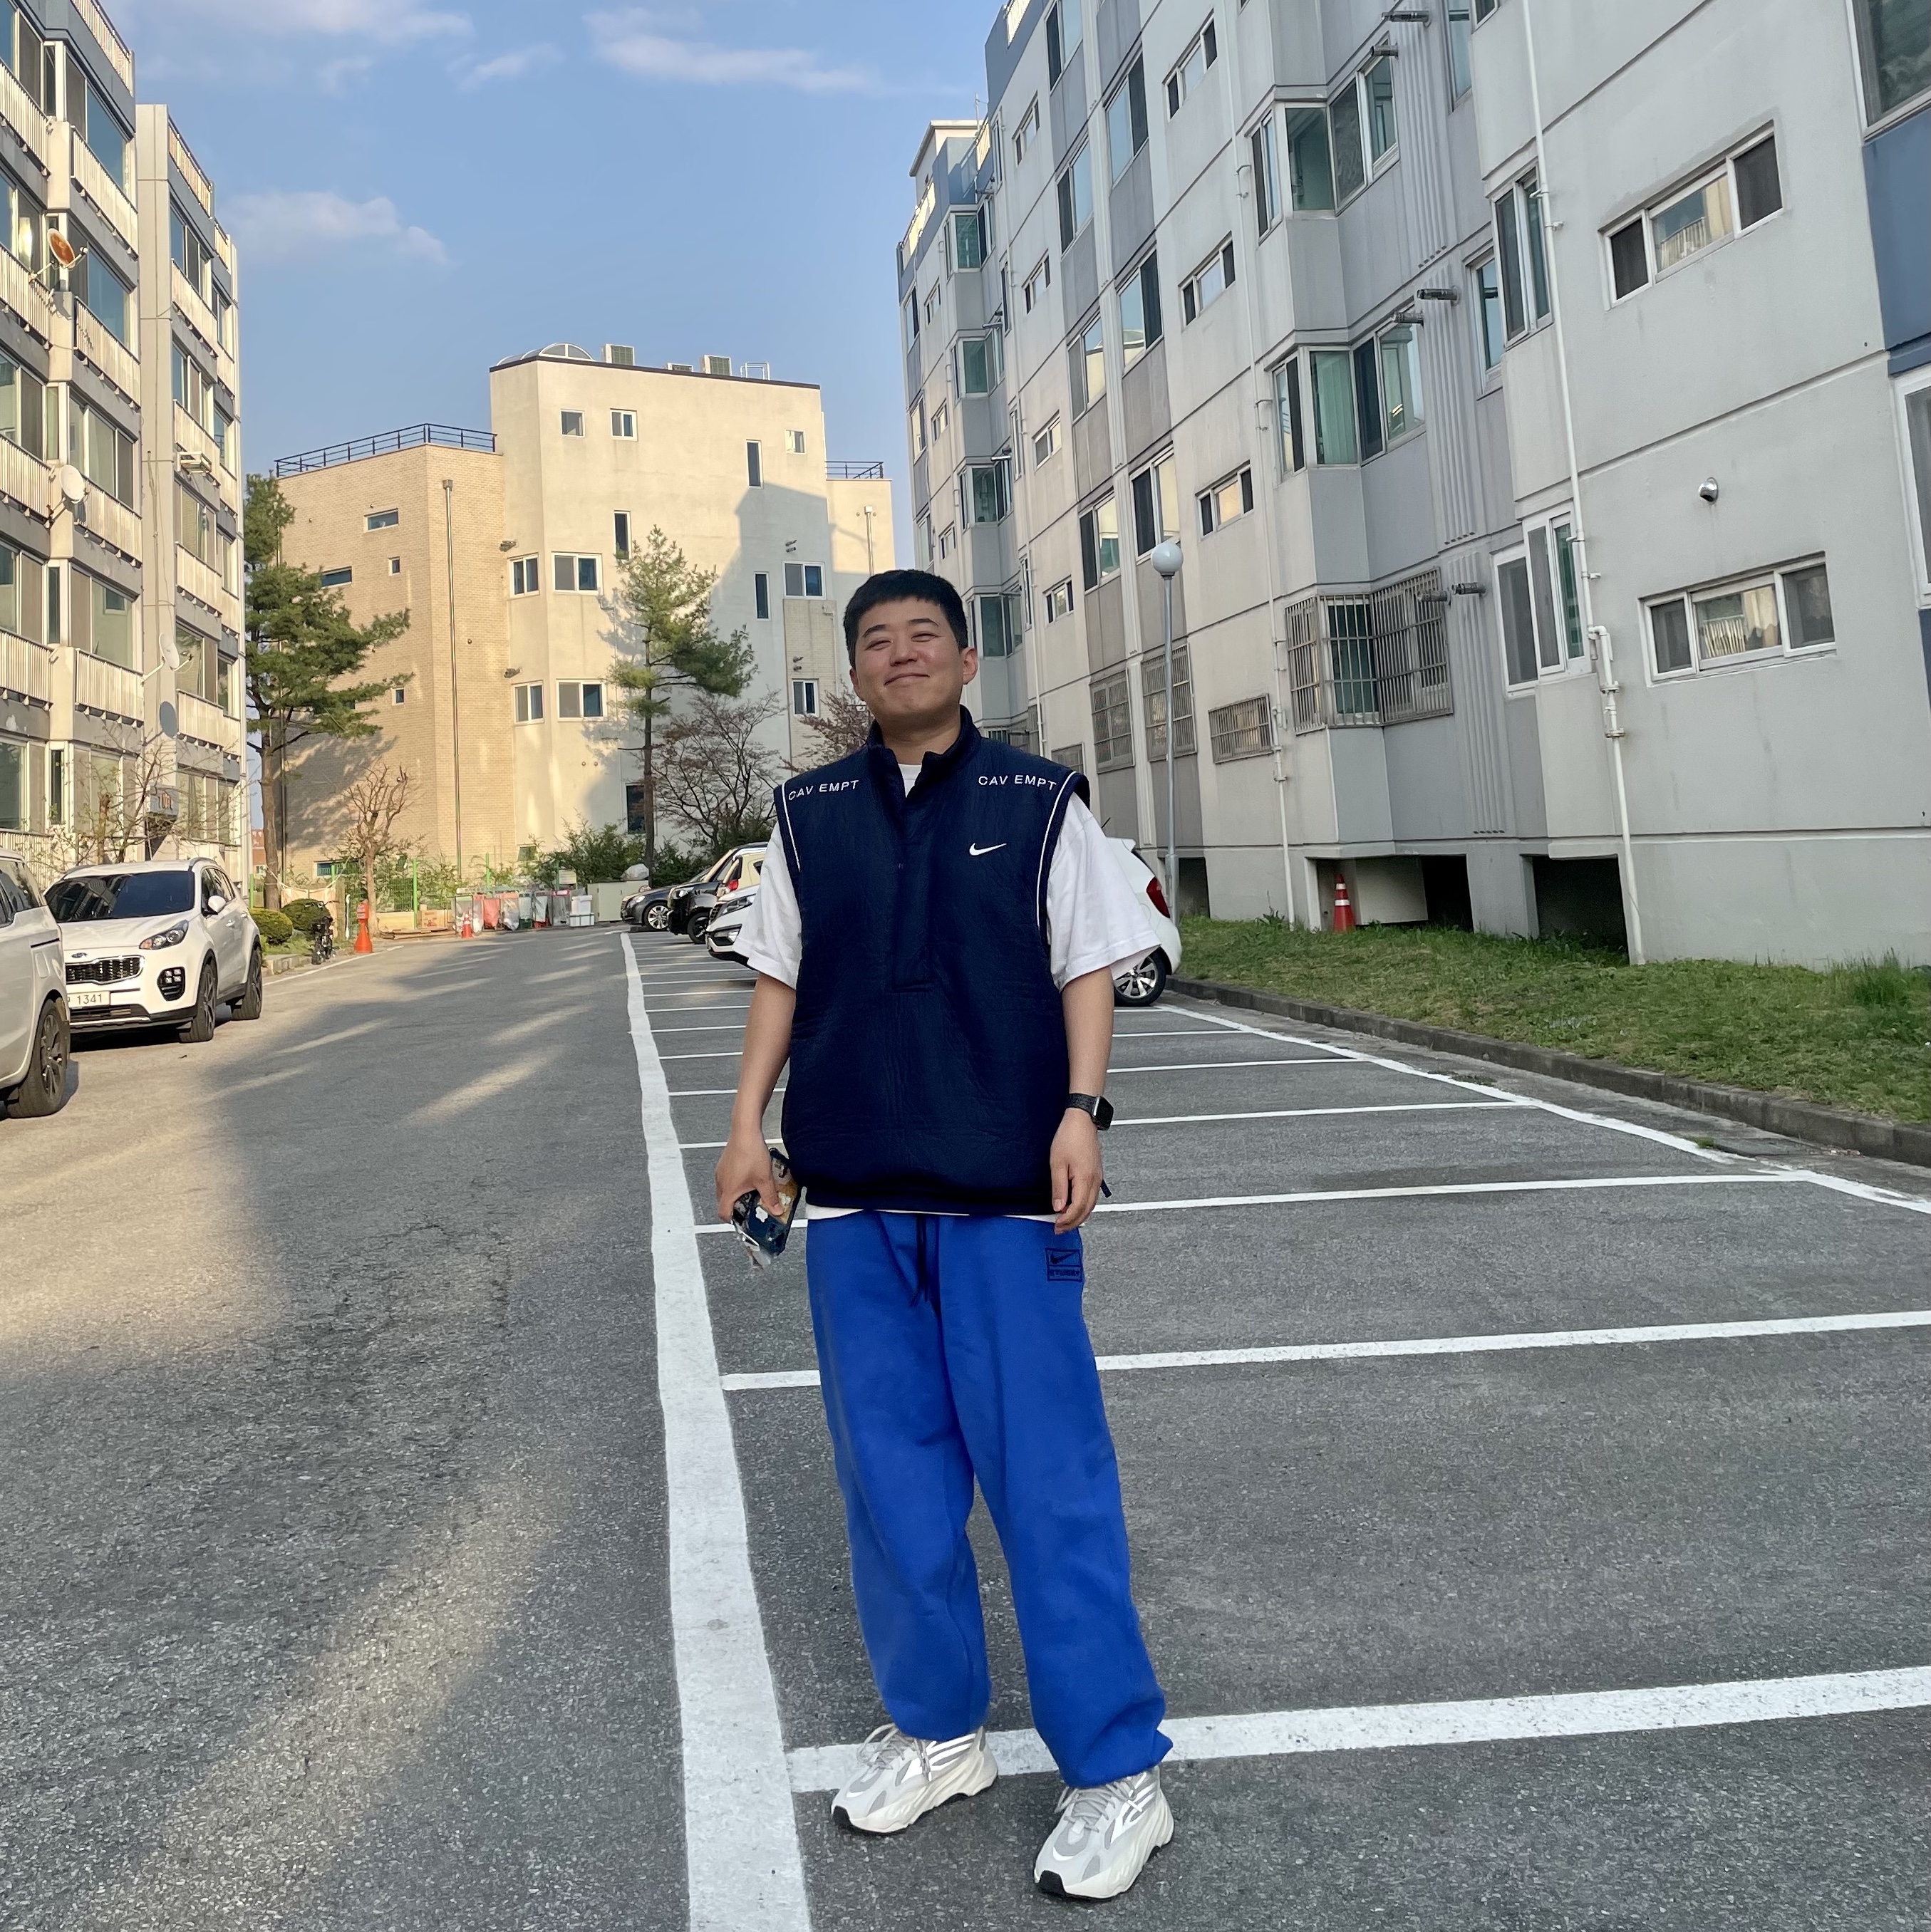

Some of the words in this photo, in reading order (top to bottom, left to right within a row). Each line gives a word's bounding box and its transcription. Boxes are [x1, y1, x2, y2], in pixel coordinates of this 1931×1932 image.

[788, 785, 814, 801] CAV
[819, 779, 859, 792] EMPT
[978, 775, 1008, 786] CAV
[1014, 774, 1057, 791] EMPT
[77, 994, 103, 1005] 1341
